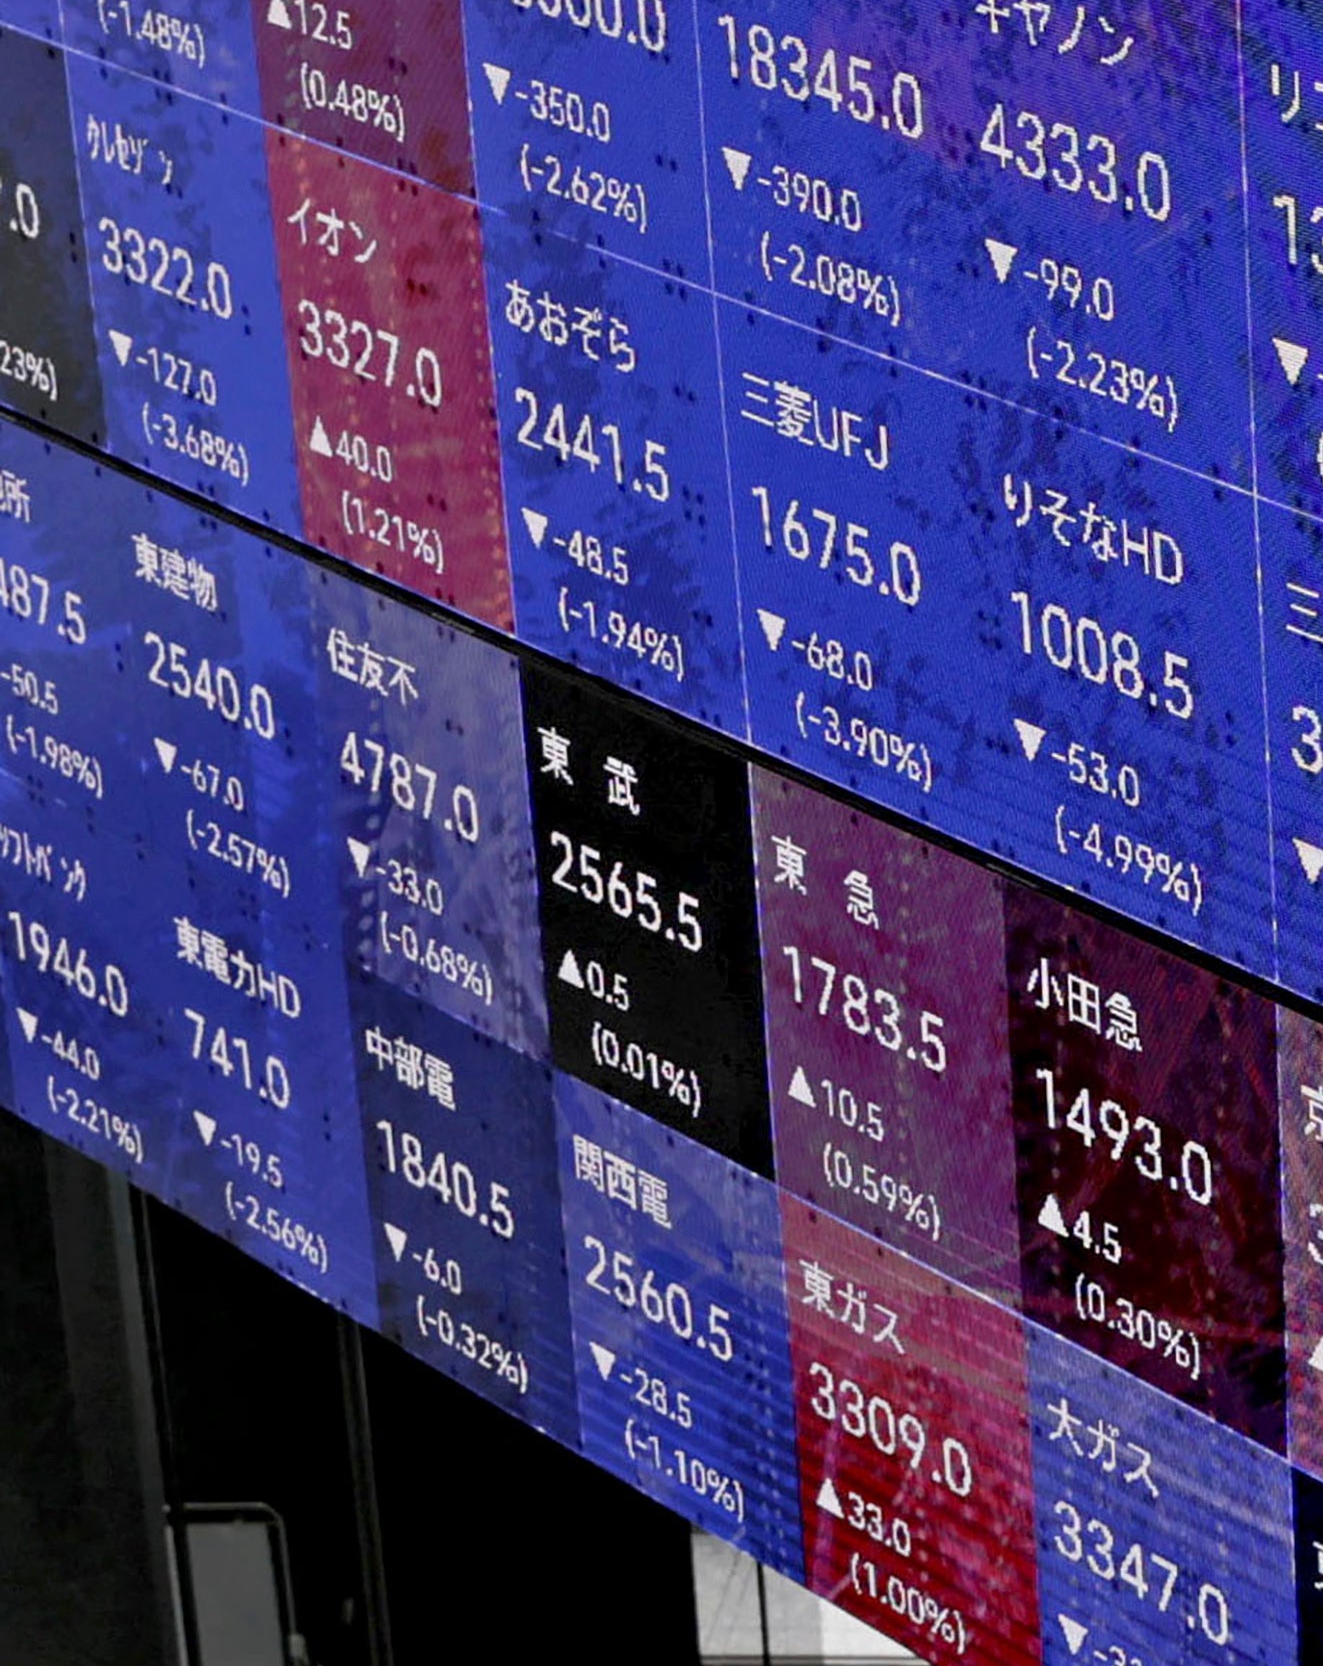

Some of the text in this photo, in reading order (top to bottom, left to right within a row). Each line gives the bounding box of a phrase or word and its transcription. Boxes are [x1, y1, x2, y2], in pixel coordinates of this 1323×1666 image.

[516, 80, 611, 143] -350.0
[718, 15, 924, 140] 18345.0
[979, 104, 1171, 222] 4333.0
[98, 217, 233, 319] 3322.0
[289, 199, 378, 264] イオン
[138, 348, 217, 406] -127.0
[298, 299, 442, 406] 3327.0
[504, 280, 635, 373] あおぞら
[741, 373, 889, 471] 三菱UFJ
[1027, 328, 1178, 432] (-2.23%)
[514, 387, 670, 503] 2441.5
[133, 534, 218, 610] 東建物
[1003, 474, 1183, 585] りそなHD
[327, 628, 418, 703] 住友不
[558, 588, 684, 681] (-1.94%)
[1011, 592, 1194, 720] 1008.5
[341, 732, 480, 841] 4787.0
[1052, 743, 1140, 807] -53.0
[186, 810, 291, 897] (-2.57%)
[551, 832, 703, 953] 2565.5
[8, 911, 129, 1017] 1946.0
[173, 917, 301, 1019] 東電力HD
[781, 944, 947, 1073] 1783.5
[1026, 958, 1144, 1053] 小田急
[184, 1008, 291, 1110] 741.0
[365, 1028, 456, 1110] 中部電
[222, 1134, 283, 1187] -19.5
[377, 1120, 515, 1238] 1840.5
[572, 1134, 672, 1229] 関西電
[1036, 1068, 1216, 1207] 1493.0
[799, 1260, 905, 1354] 東ガス
[1075, 1274, 1200, 1379] (0.30%)
[624, 1417, 744, 1523] (-1.10%)
[810, 1362, 972, 1496] 3309.0
[1046, 1398, 1161, 1497] 大ガス
[1053, 1501, 1232, 1645] 3347.0
